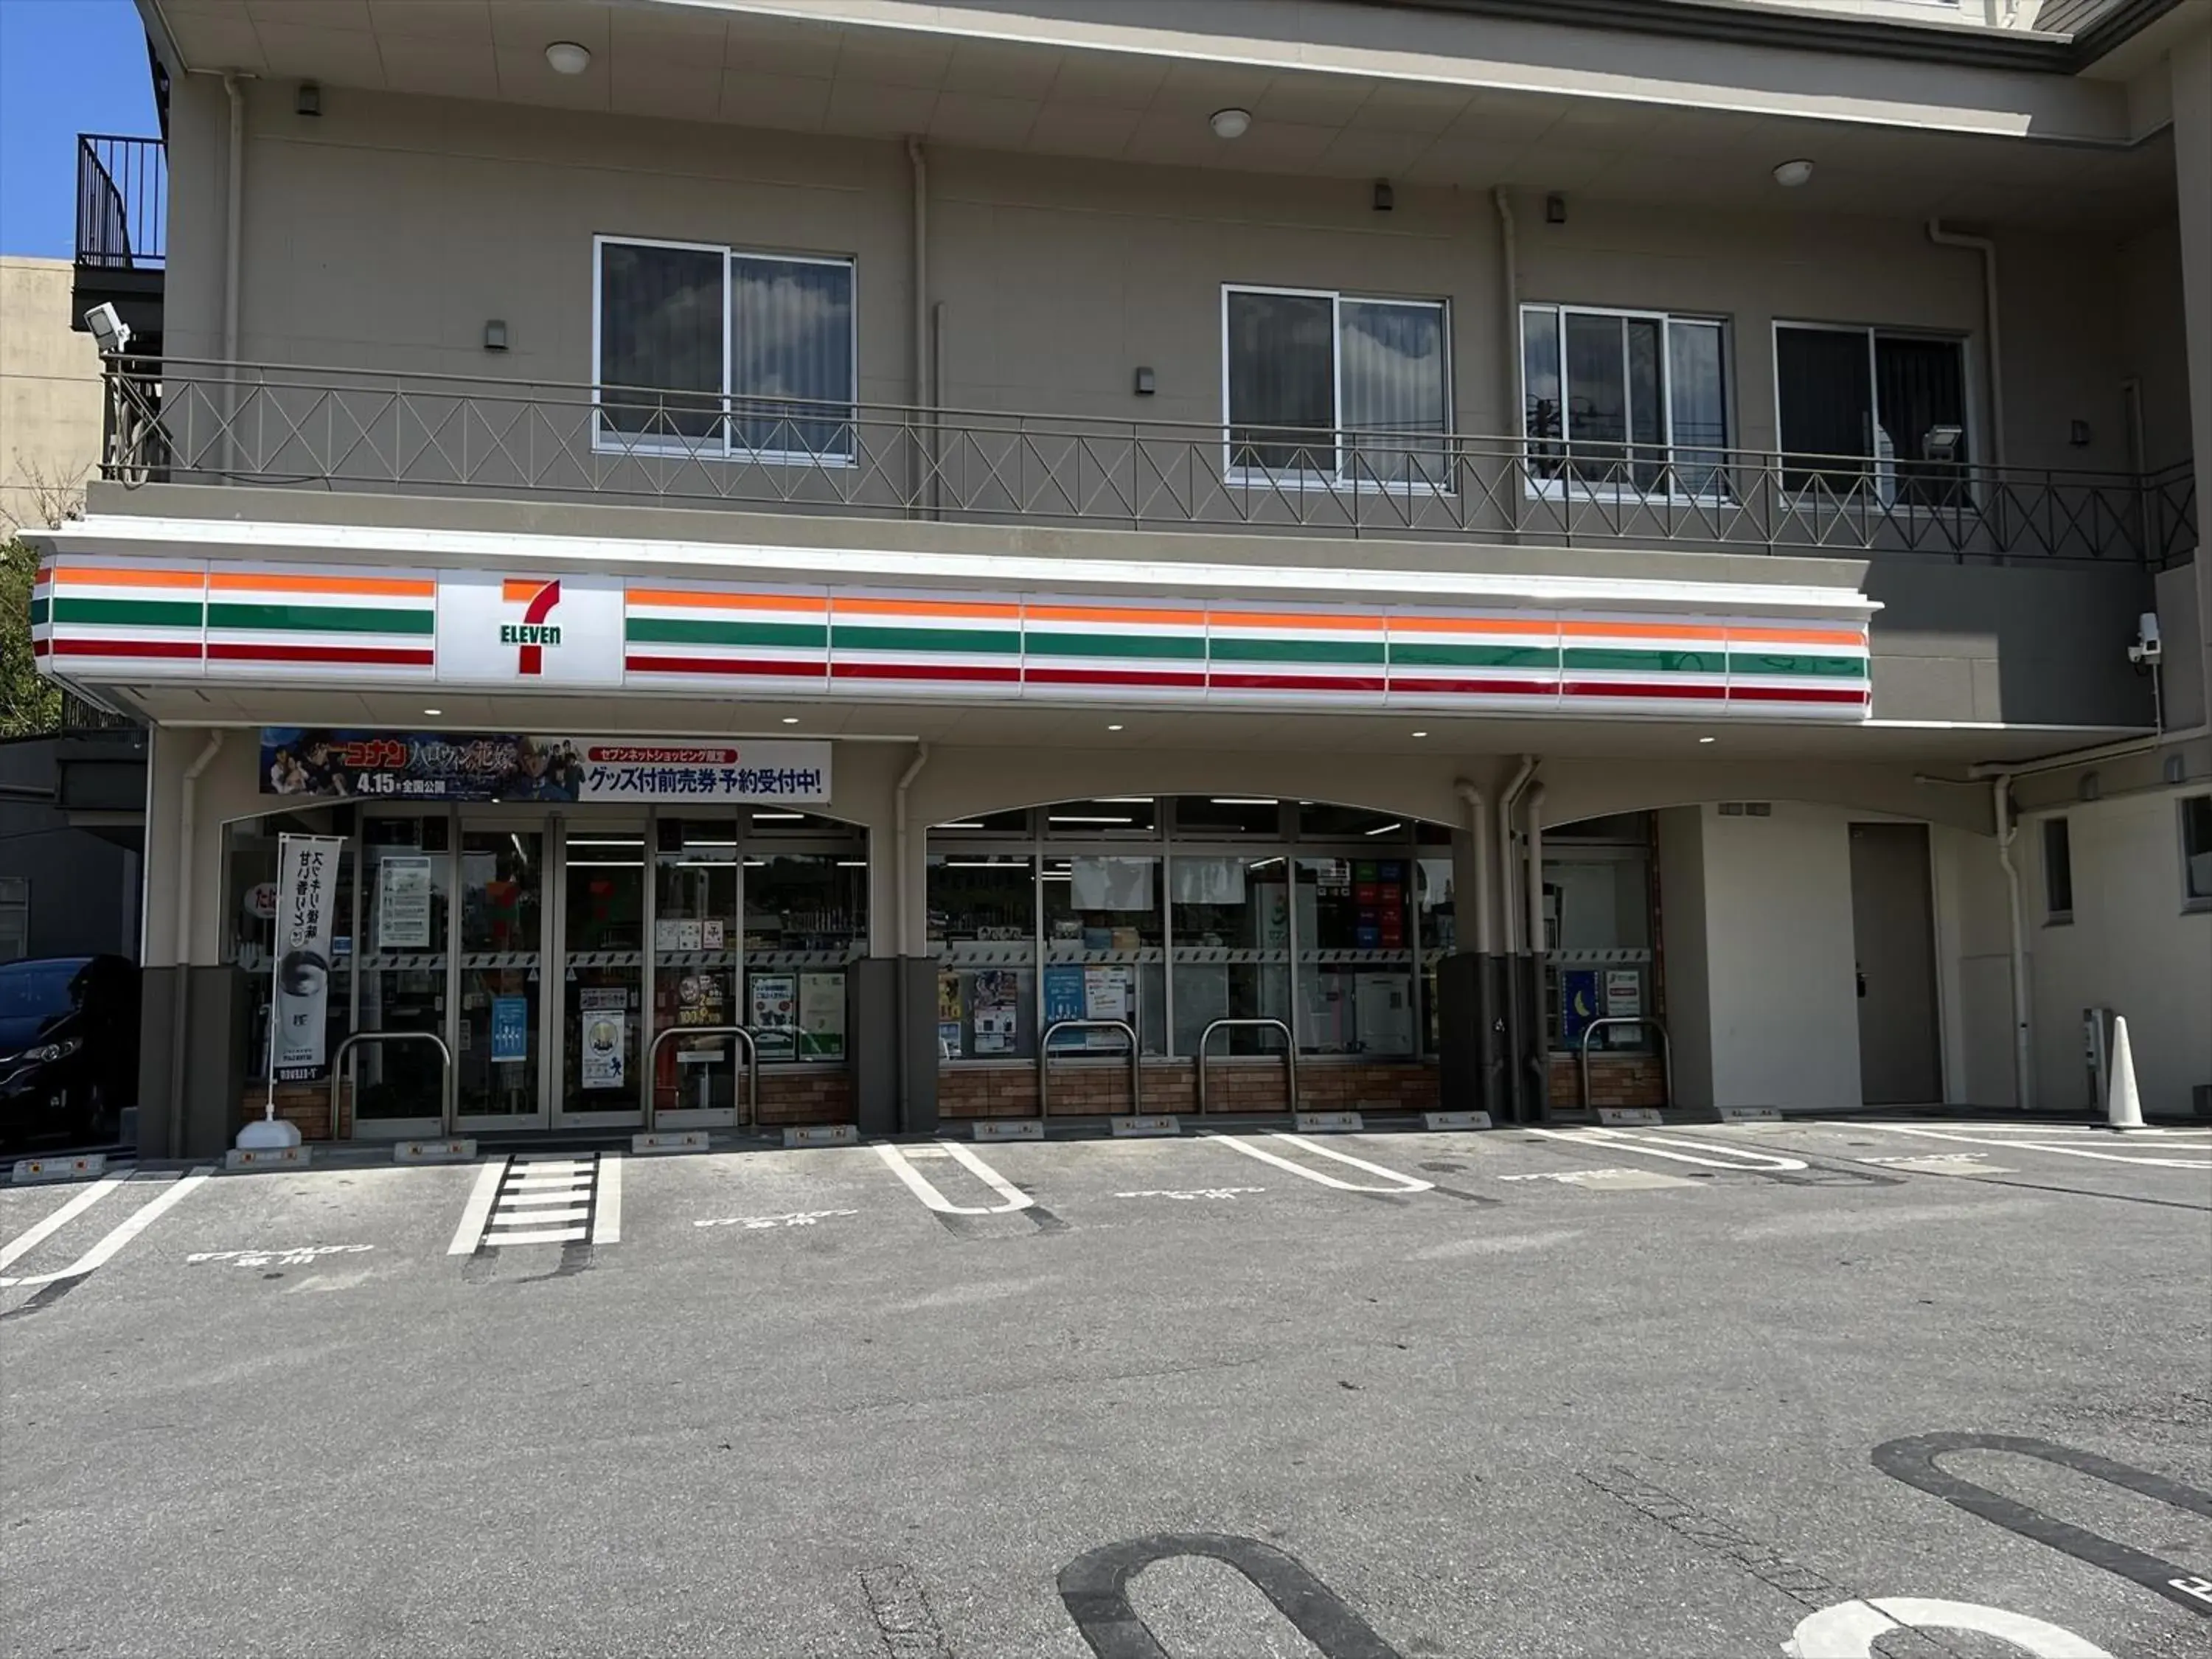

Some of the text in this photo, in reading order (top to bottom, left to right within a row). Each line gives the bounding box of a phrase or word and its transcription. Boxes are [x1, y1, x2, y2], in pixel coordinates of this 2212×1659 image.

[344, 739, 406, 768] コナン
[357, 771, 394, 794] 4.15
[588, 765, 822, 794] グッズ付前売券 予約受付中!
